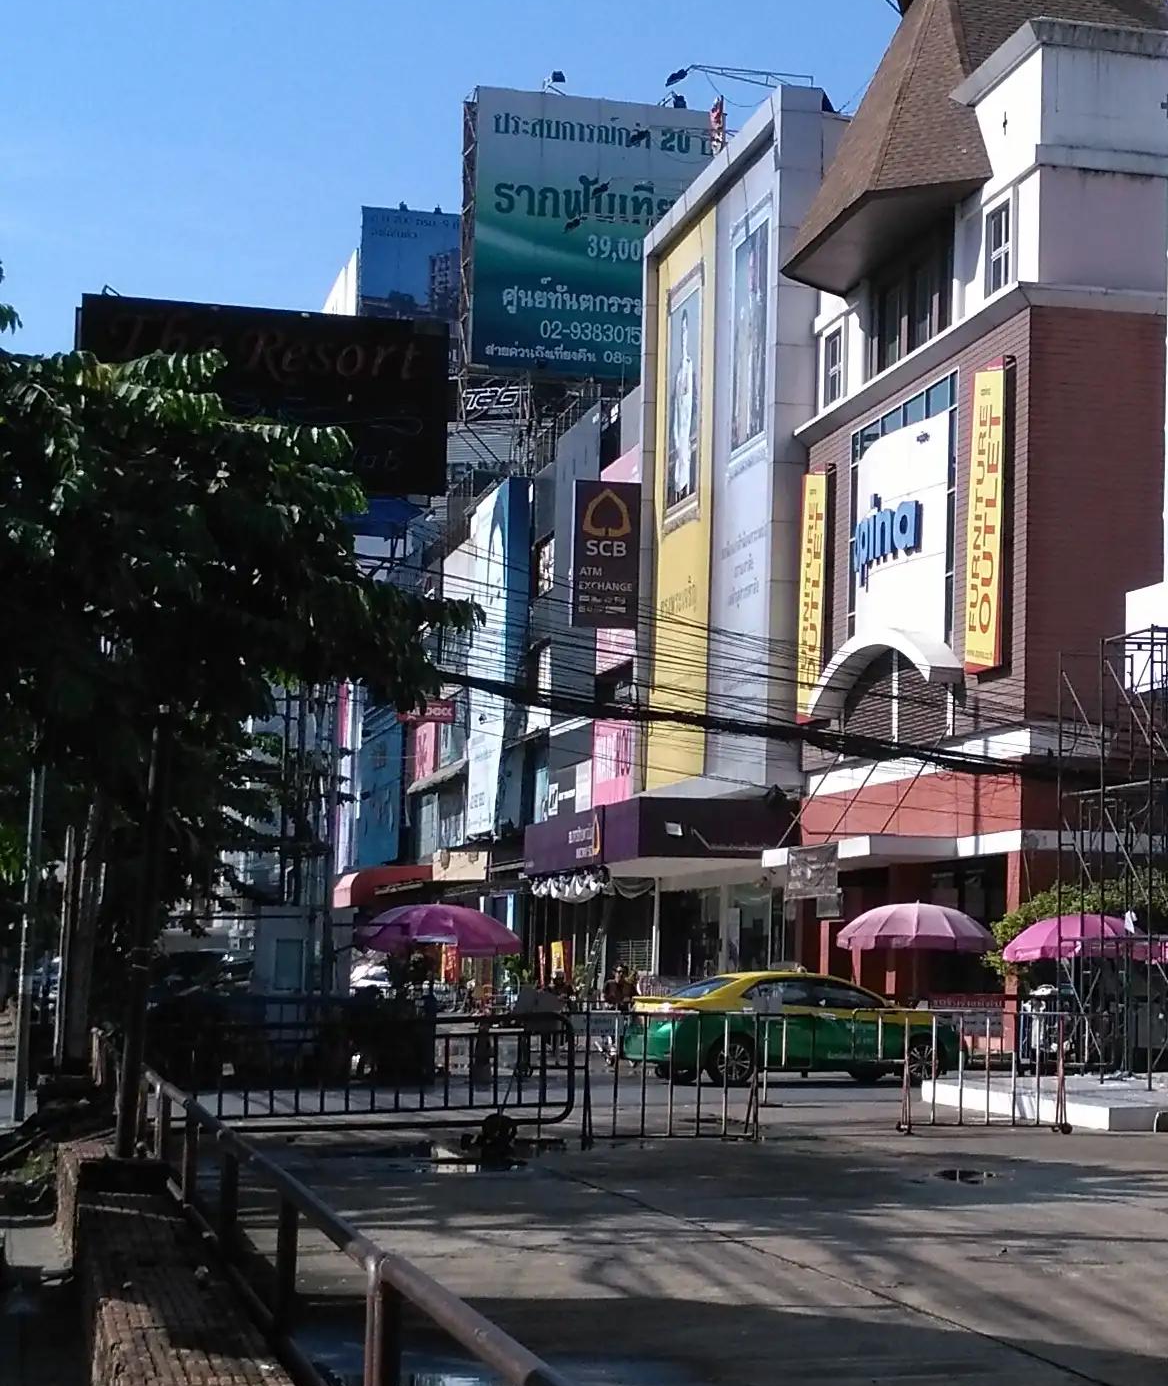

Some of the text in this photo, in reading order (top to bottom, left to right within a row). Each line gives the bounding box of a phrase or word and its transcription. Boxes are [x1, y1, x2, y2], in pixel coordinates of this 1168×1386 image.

[660, 128, 691, 154] 20
[540, 319, 642, 346] 02-9383015
[968, 403, 990, 633] FURNITURE
[978, 404, 1002, 635] OUTLET
[585, 539, 628, 558] SCB
[579, 565, 602, 578] ATM
[578, 580, 633, 593] EXCHANGE
